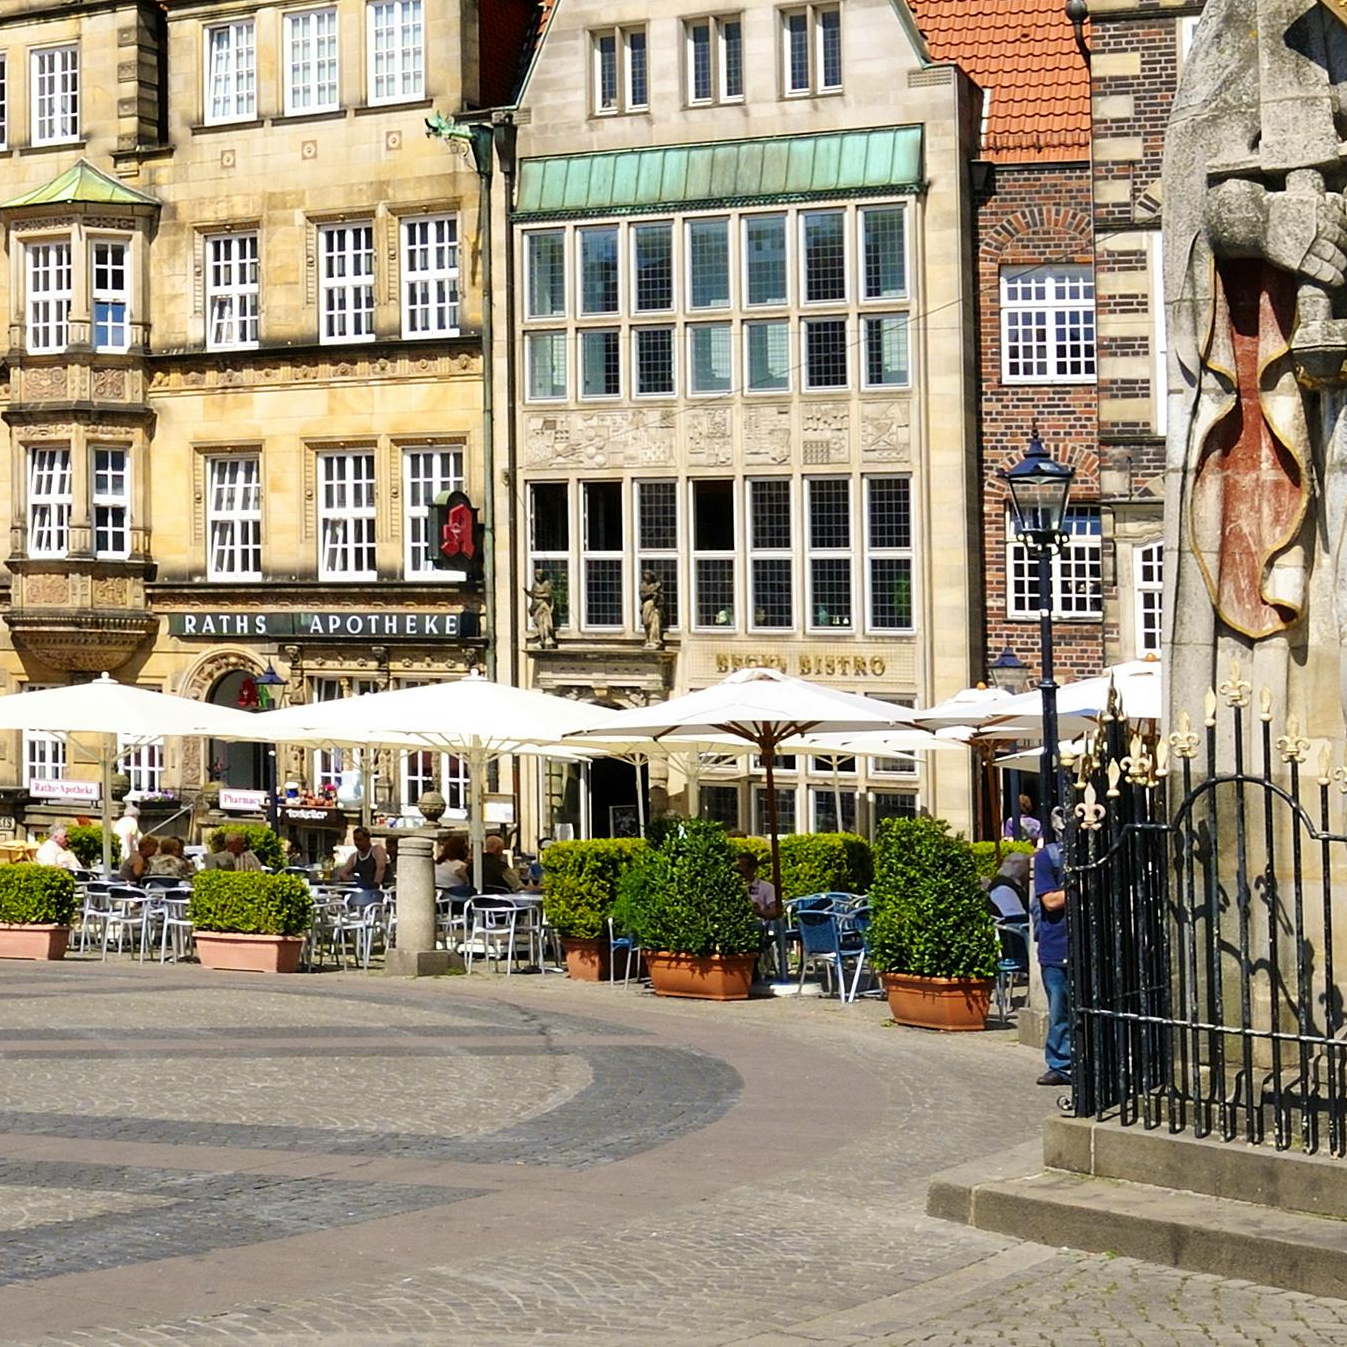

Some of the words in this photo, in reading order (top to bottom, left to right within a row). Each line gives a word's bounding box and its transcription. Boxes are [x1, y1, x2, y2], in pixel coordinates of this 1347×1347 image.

[184, 615, 267, 635] RATHS
[309, 614, 459, 635] APOTHEKE
[799, 655, 886, 676] BISTRO
[34, 783, 94, 795] Raths-Apotheke
